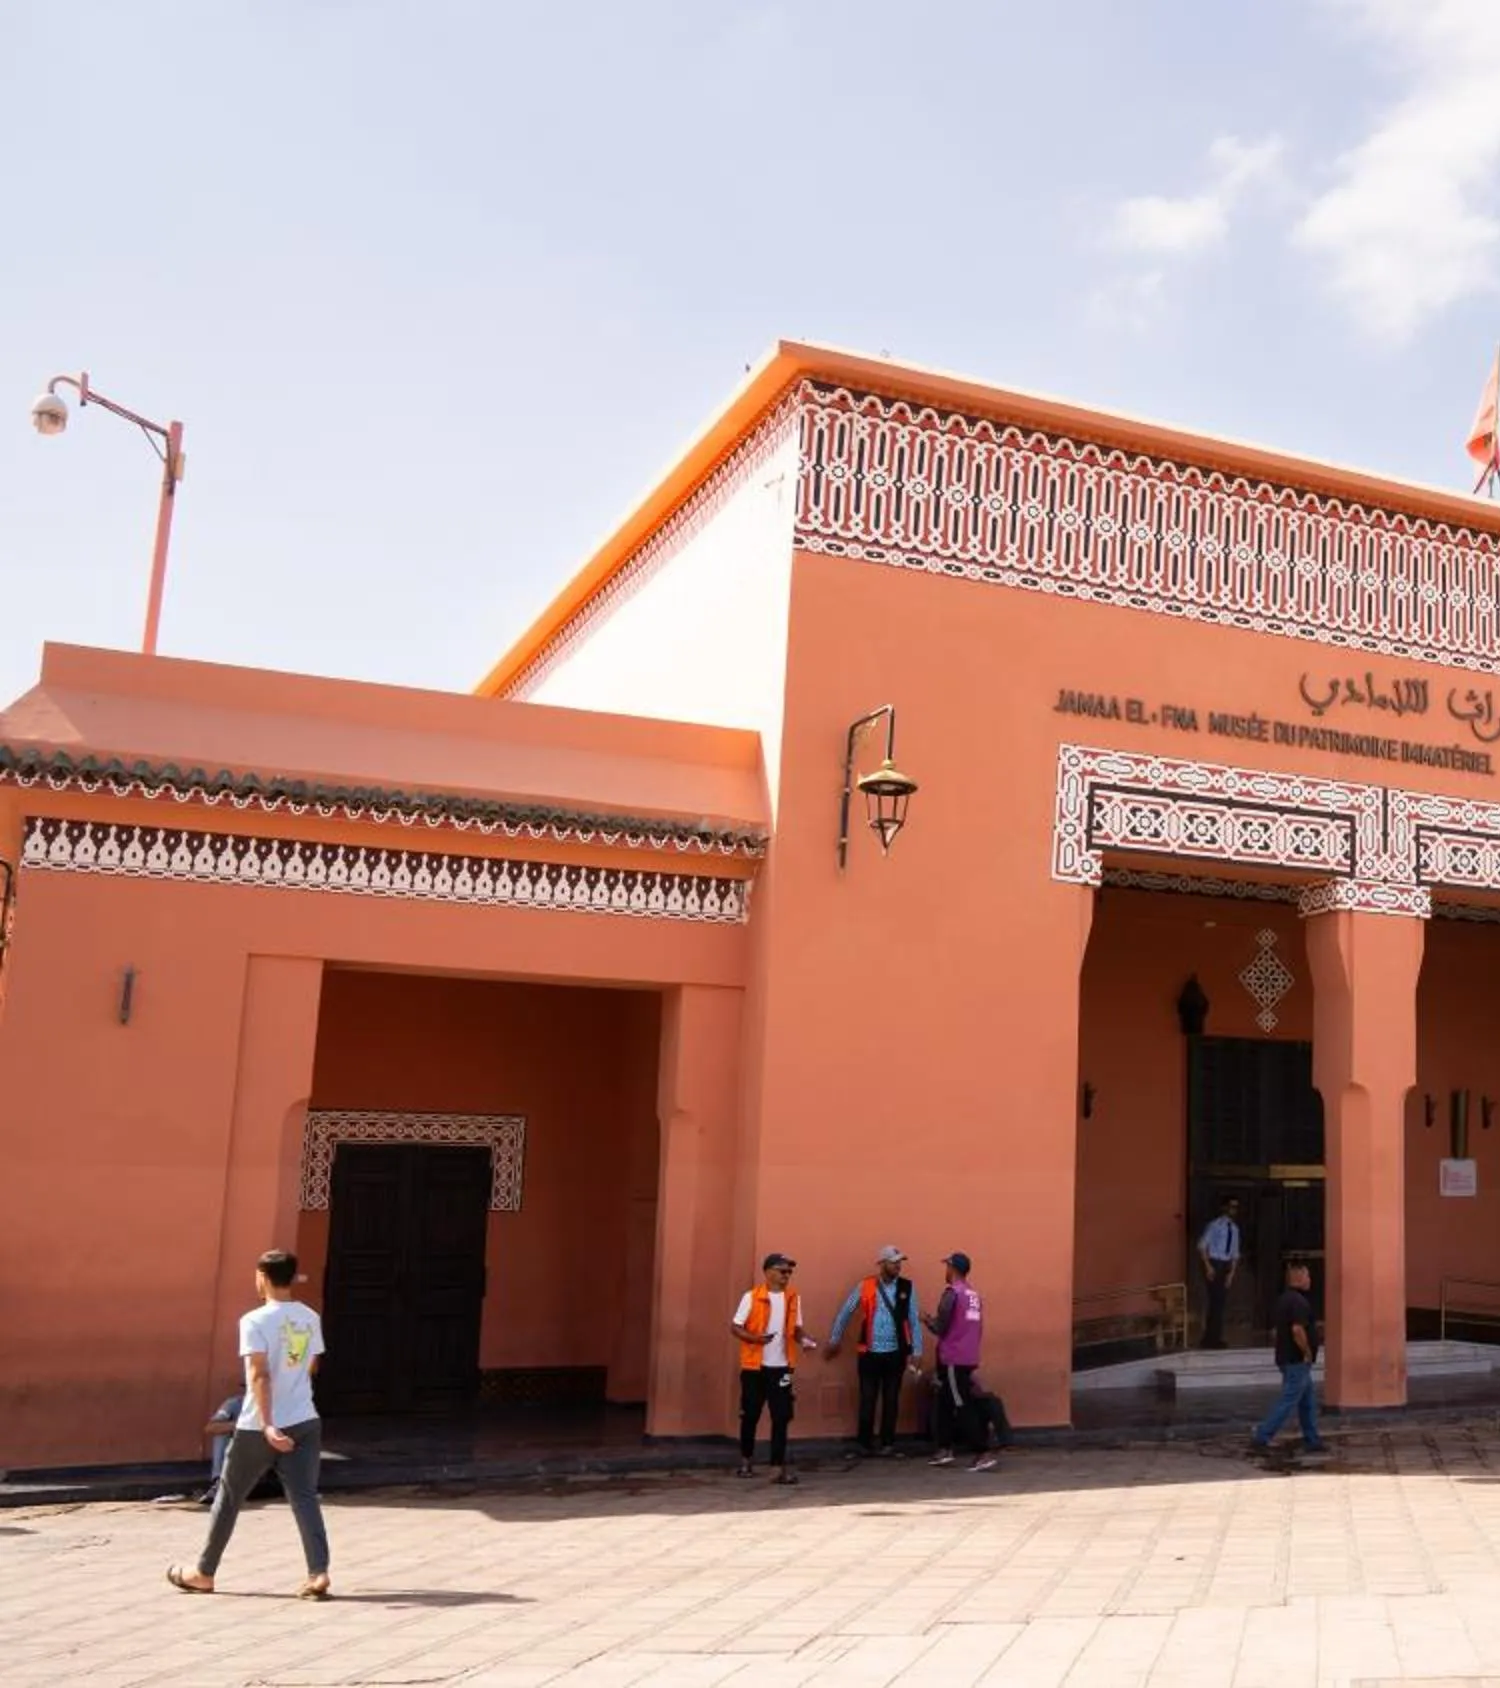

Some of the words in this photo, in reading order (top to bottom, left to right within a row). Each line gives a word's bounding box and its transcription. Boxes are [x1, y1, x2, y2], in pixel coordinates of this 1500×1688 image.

[1298, 670, 1430, 718] اللامادي
[1053, 689, 1122, 721] JAMAA
[1208, 711, 1269, 743] MUSÉE
[1273, 721, 1297, 746] DU
[1299, 725, 1399, 761] PATRIMOINE
[1401, 733, 1495, 775] IMMATÉRIEL
